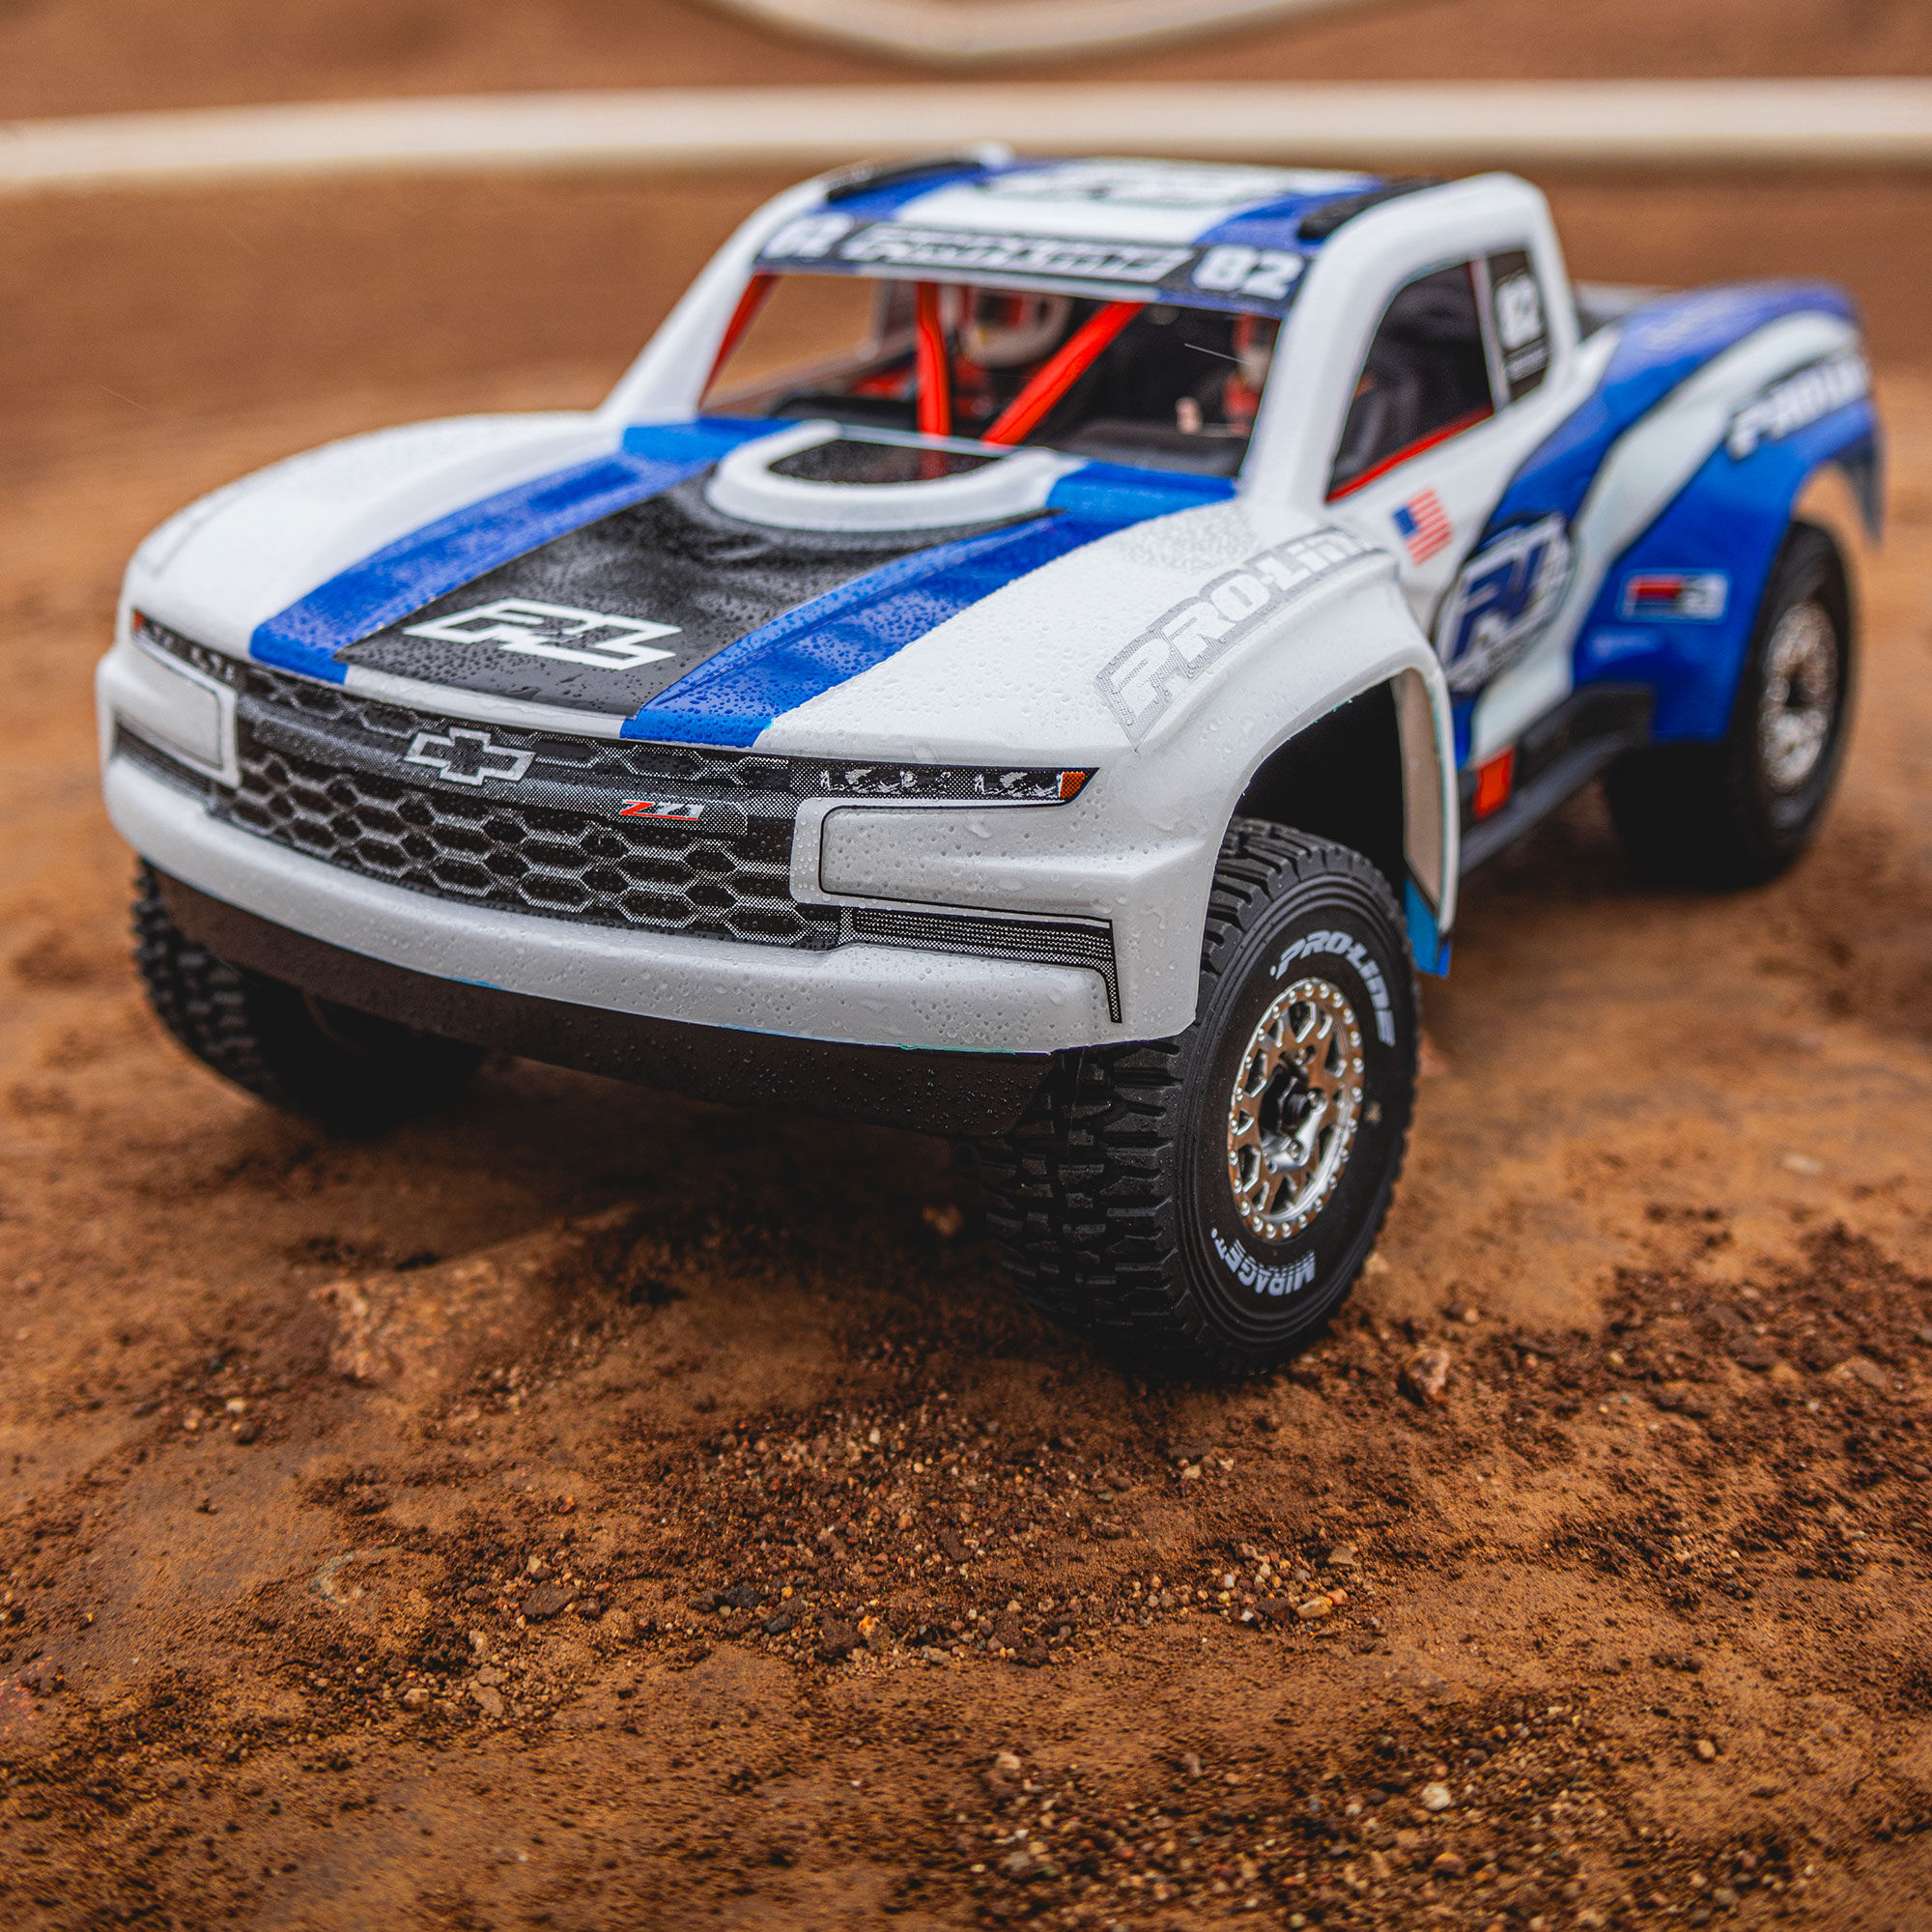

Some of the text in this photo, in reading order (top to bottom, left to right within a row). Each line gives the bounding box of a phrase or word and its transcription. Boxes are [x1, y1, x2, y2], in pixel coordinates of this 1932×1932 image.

[1191, 243, 1305, 300] 82
[619, 800, 705, 821] Z71
[1224, 1238, 1316, 1297] MIRAGE
